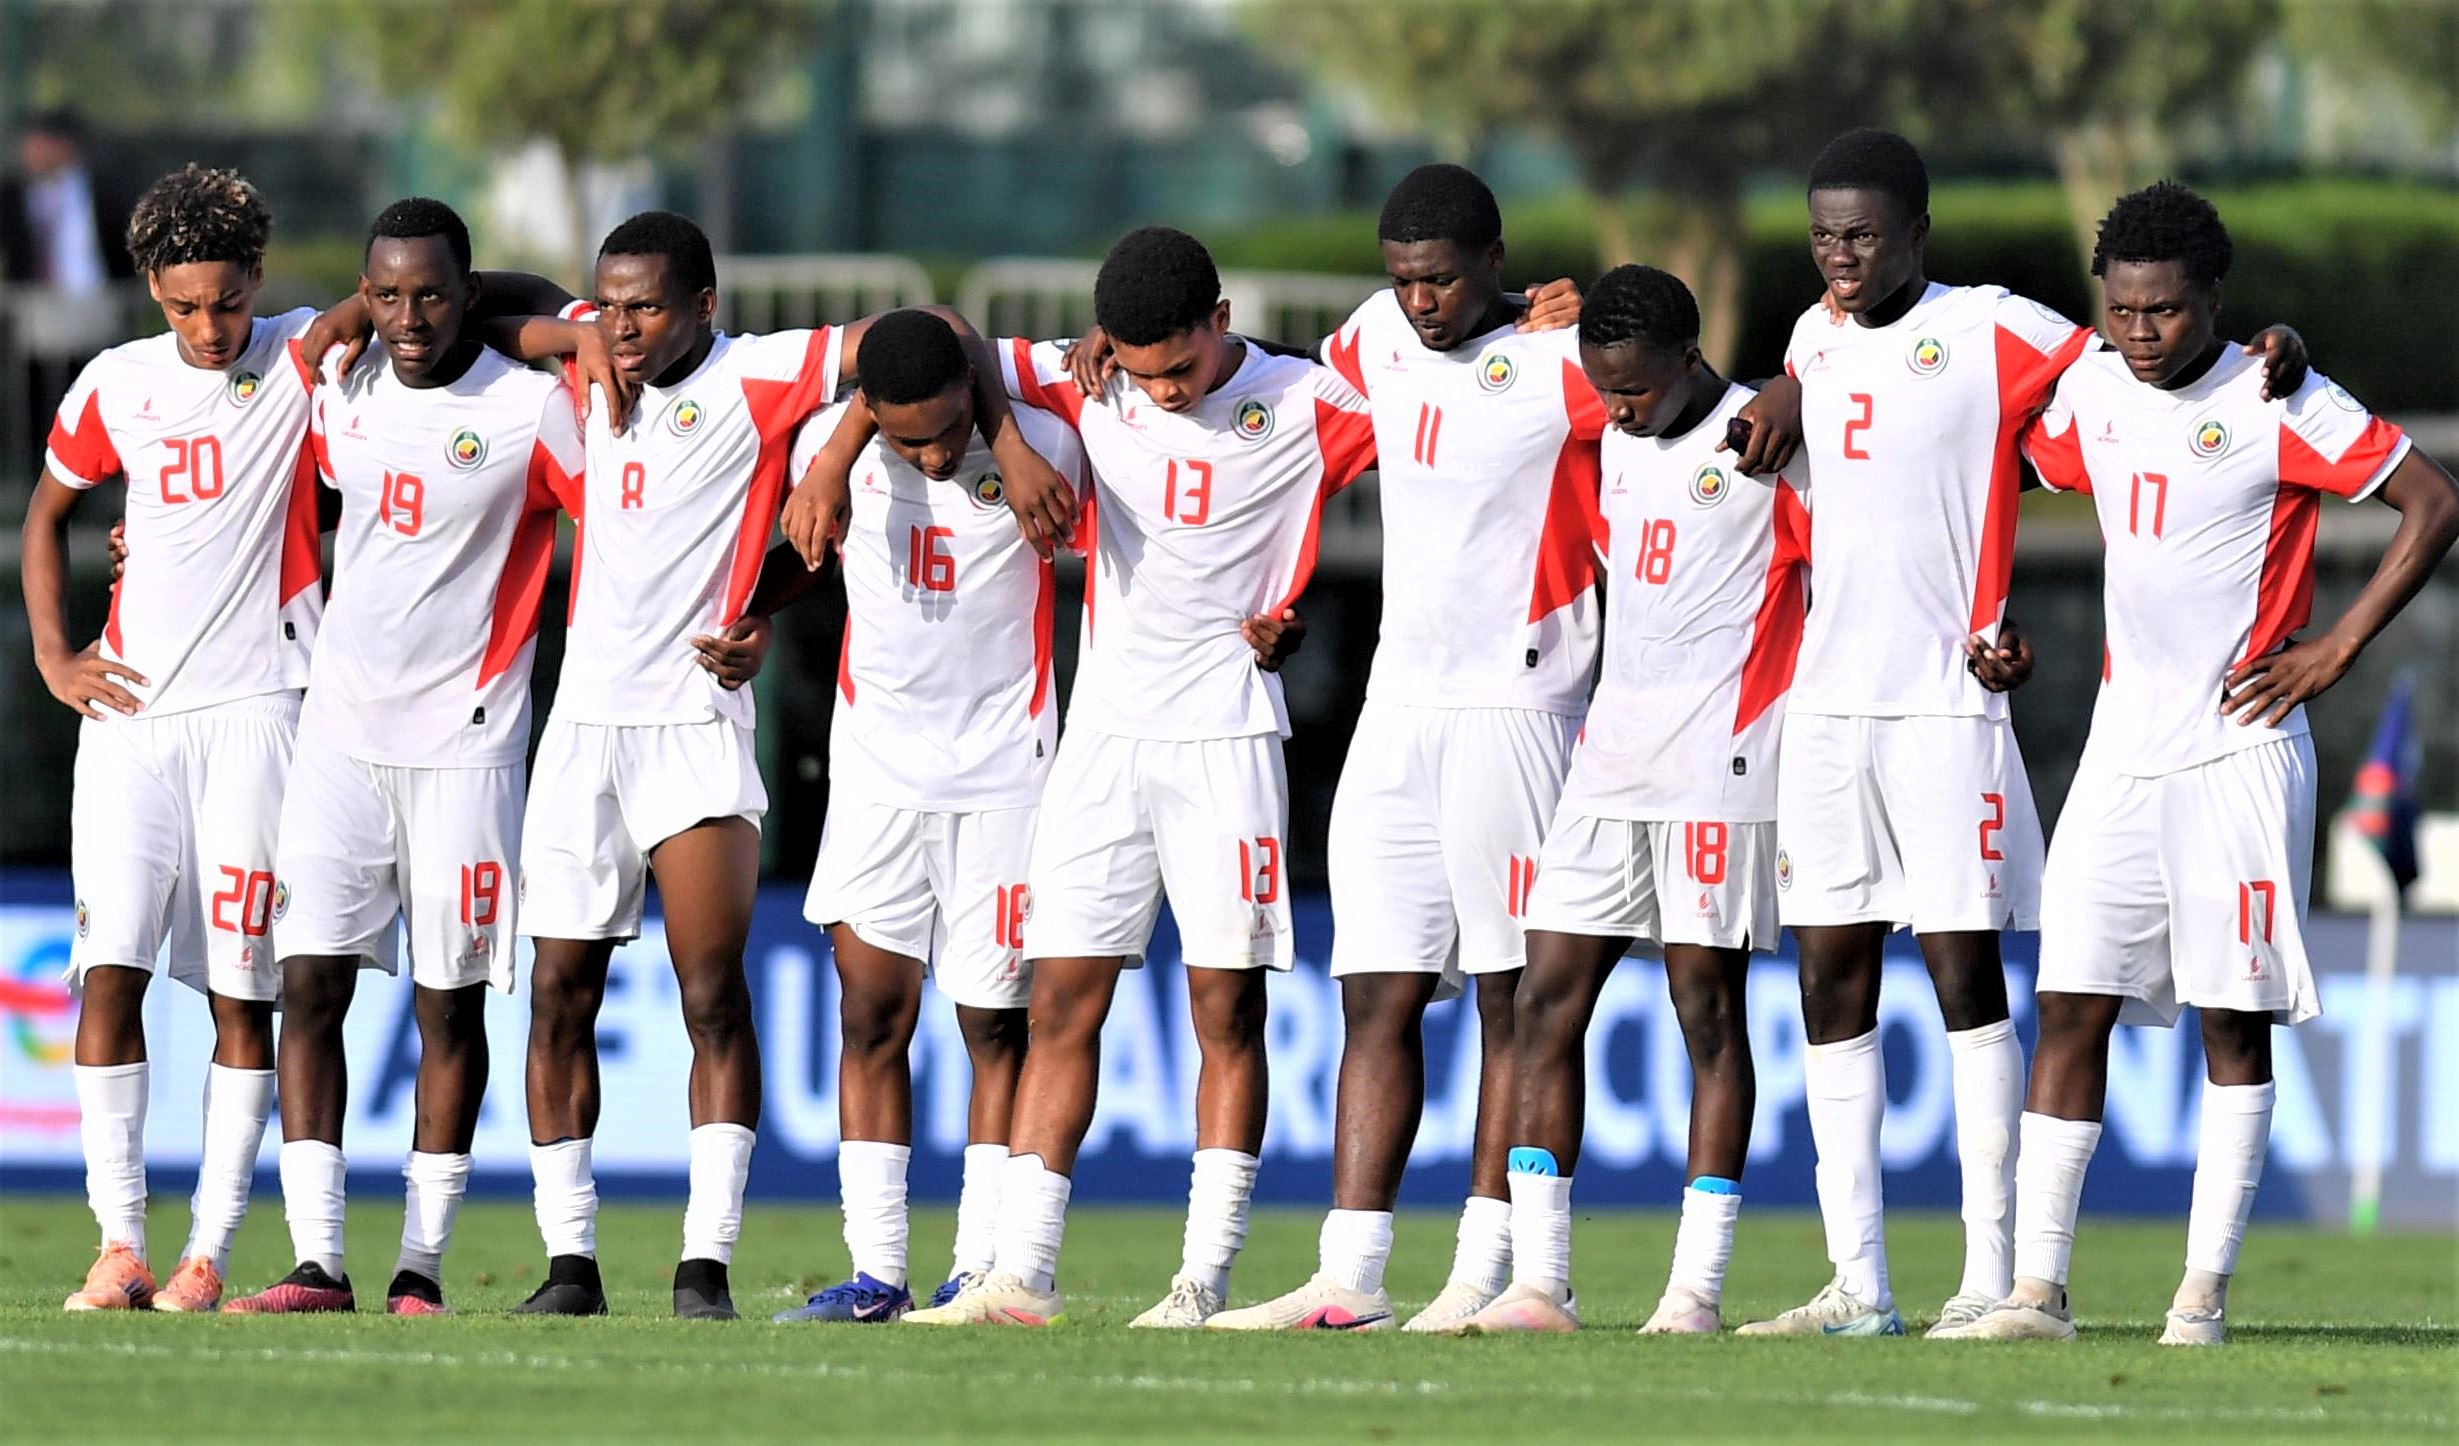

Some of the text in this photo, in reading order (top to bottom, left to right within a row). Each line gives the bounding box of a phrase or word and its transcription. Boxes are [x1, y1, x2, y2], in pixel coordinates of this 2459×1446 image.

[1413, 402, 1443, 469] 11
[1843, 392, 1873, 460] 2
[159, 434, 225, 505] 20
[621, 461, 646, 510] 8
[1163, 459, 1213, 526] 13
[380, 470, 425, 537] 19
[2129, 472, 2169, 540] 17
[909, 526, 956, 592] 16
[1634, 518, 1677, 586] 18
[1684, 821, 1728, 885] 18
[1979, 792, 2004, 861] 2
[212, 864, 275, 937] 20
[460, 861, 503, 927] 19
[1238, 837, 1279, 905] 13
[1508, 854, 1534, 920] 11
[2238, 880, 2276, 947] 17
